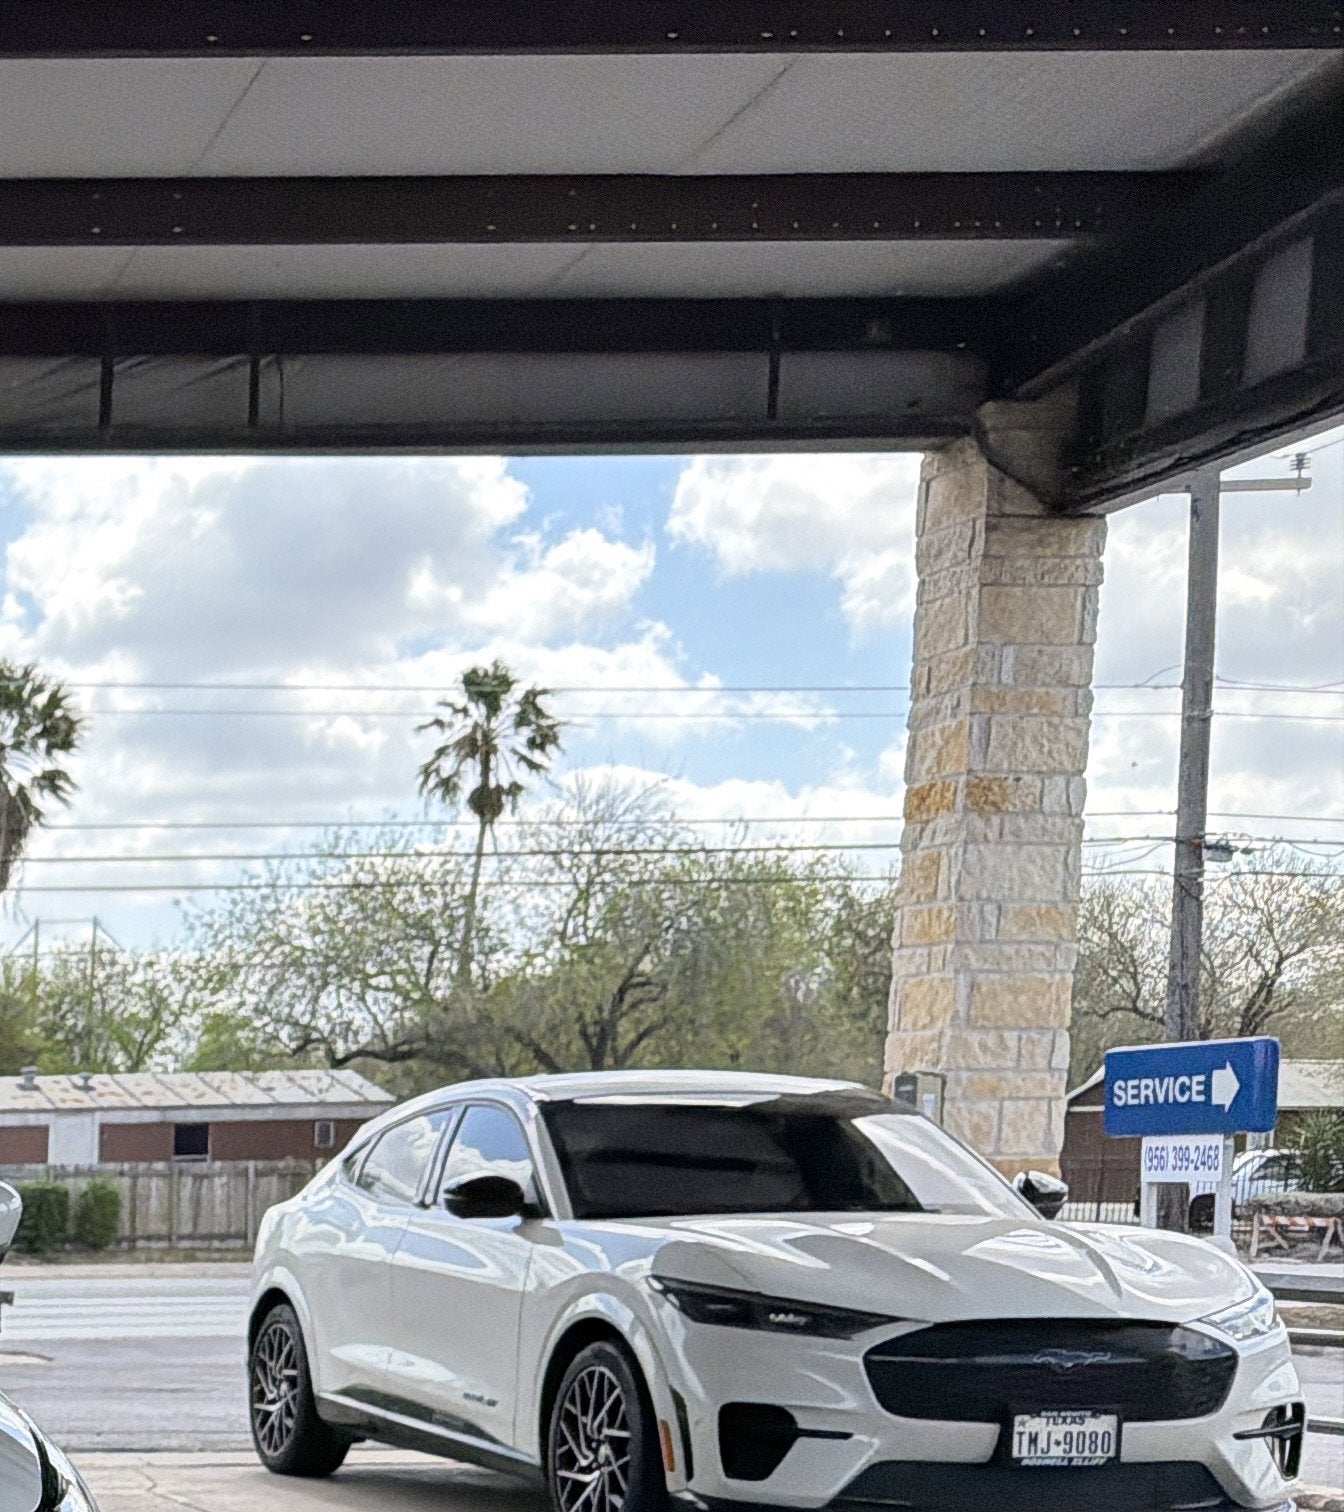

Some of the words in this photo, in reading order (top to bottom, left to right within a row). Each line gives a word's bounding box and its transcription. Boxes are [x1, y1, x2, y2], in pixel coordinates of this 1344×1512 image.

[1112, 1074, 1206, 1107] SERVICE
[1144, 1146, 1169, 1172] (956)
[1171, 1144, 1220, 1172] 399-2468
